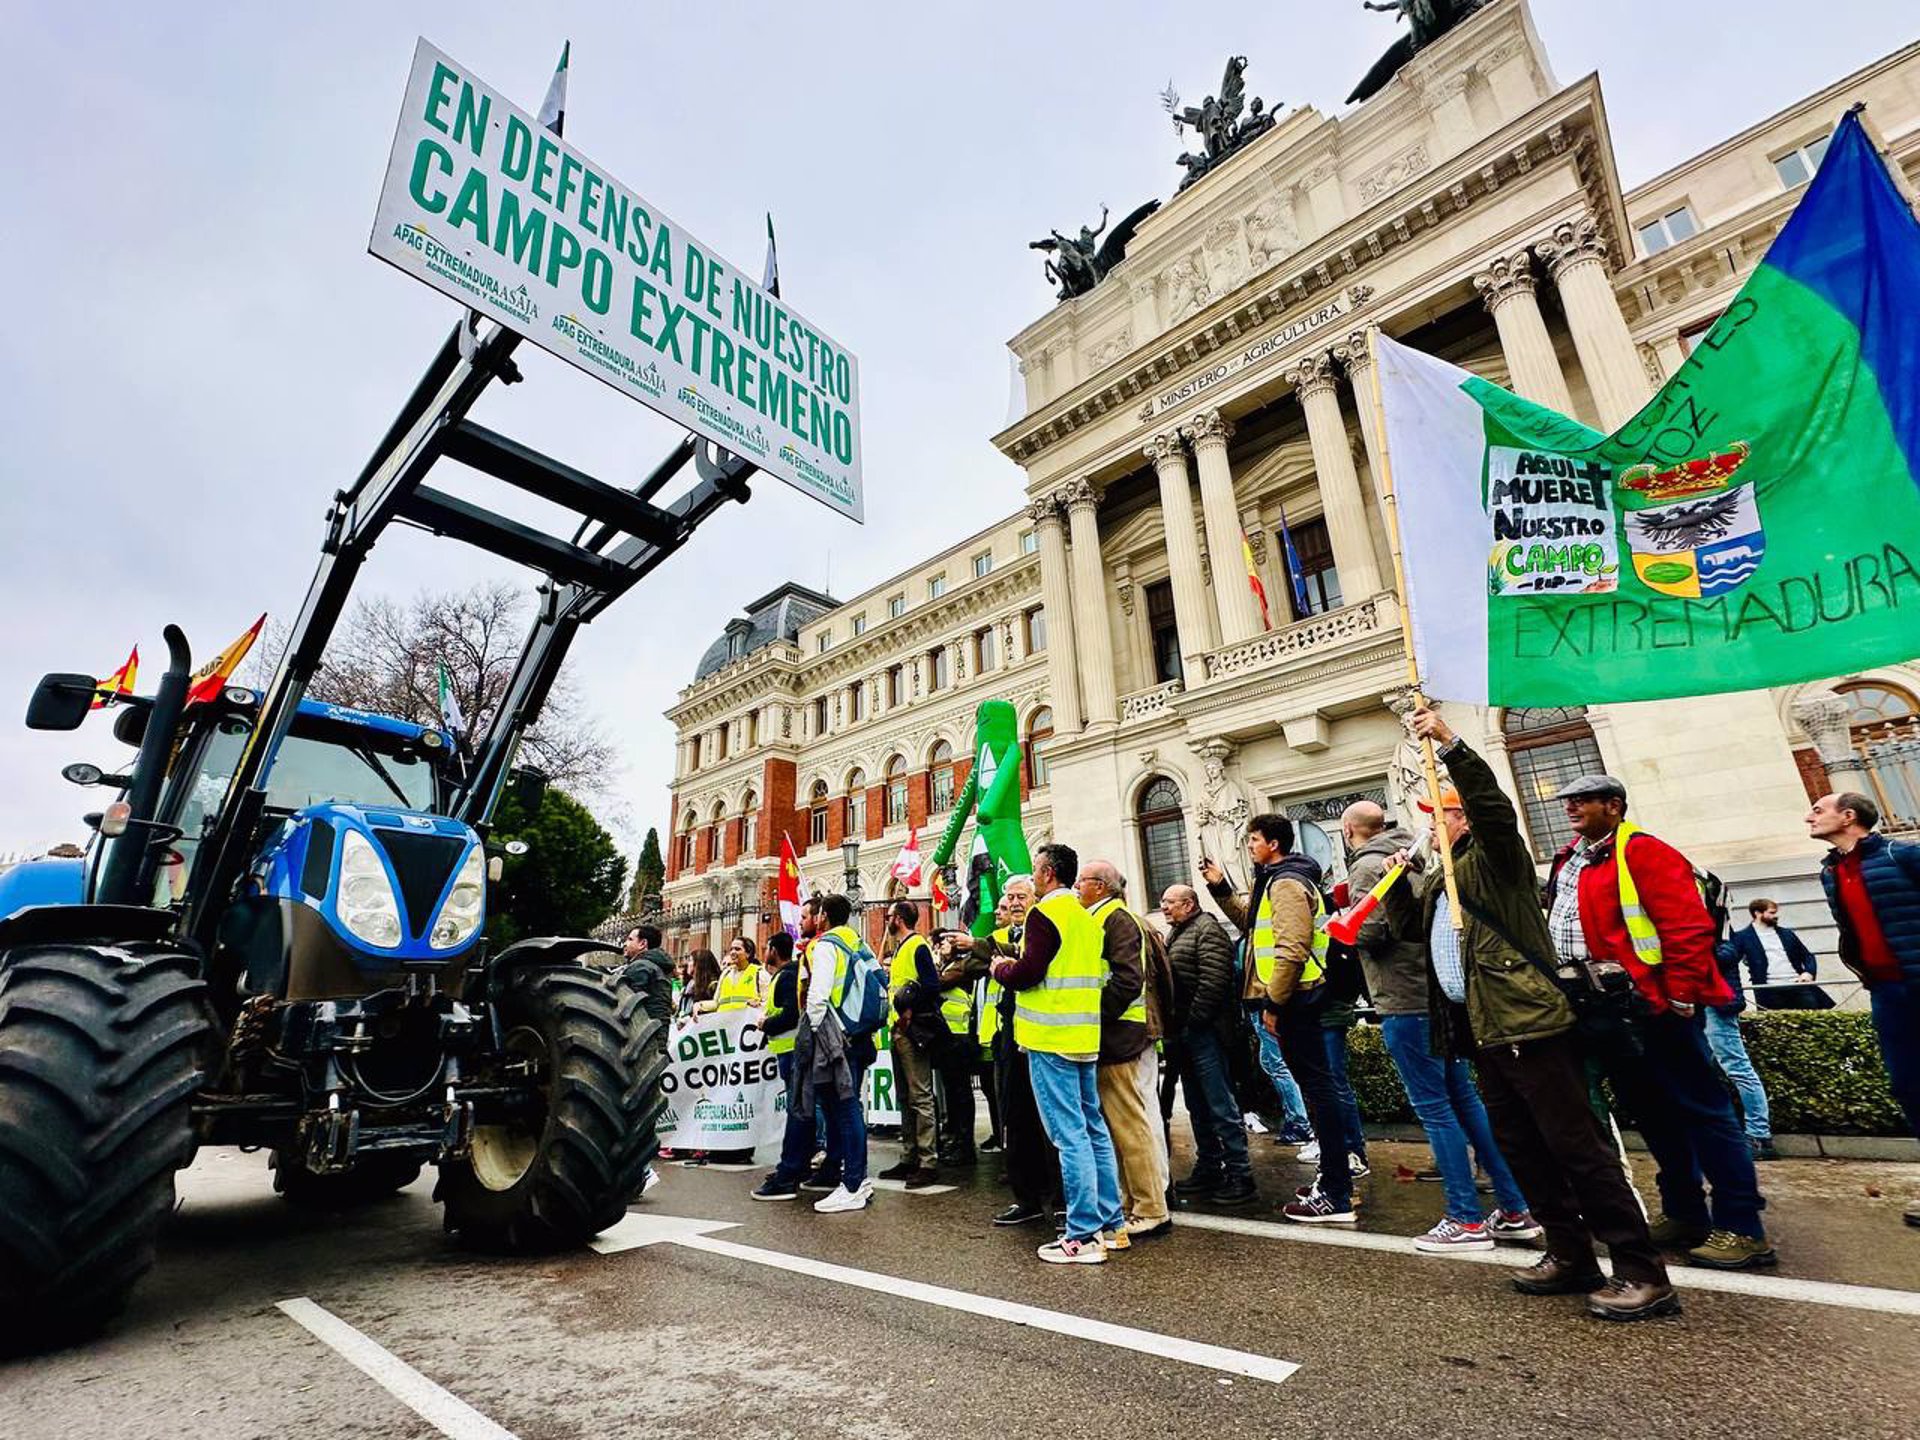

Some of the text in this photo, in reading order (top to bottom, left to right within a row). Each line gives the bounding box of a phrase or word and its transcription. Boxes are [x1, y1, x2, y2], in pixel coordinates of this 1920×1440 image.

[424, 61, 850, 405] EN DEFENSA DE NUESTRO
[393, 223, 539, 318] APAG EXTREMADURA ASAJA
[426, 260, 480, 295] AGRICULTORES
[409, 138, 852, 465] CAMPO EXTREMEÑO
[552, 315, 666, 393] APAG EXTREMADURA ASAJA
[1160, 366, 1227, 410] MINISTERIO
[1242, 303, 1341, 365] AGRICULTURA
[1492, 478, 1594, 505] MUERE
[1495, 507, 1605, 541] NUESTRO
[1506, 543, 1604, 576] CAMPO
[1514, 542, 1920, 659] EXTREMADURA
[678, 1029, 735, 1062] DEL
[740, 1024, 769, 1052] CA
[684, 1057, 778, 1089] CONSEG
